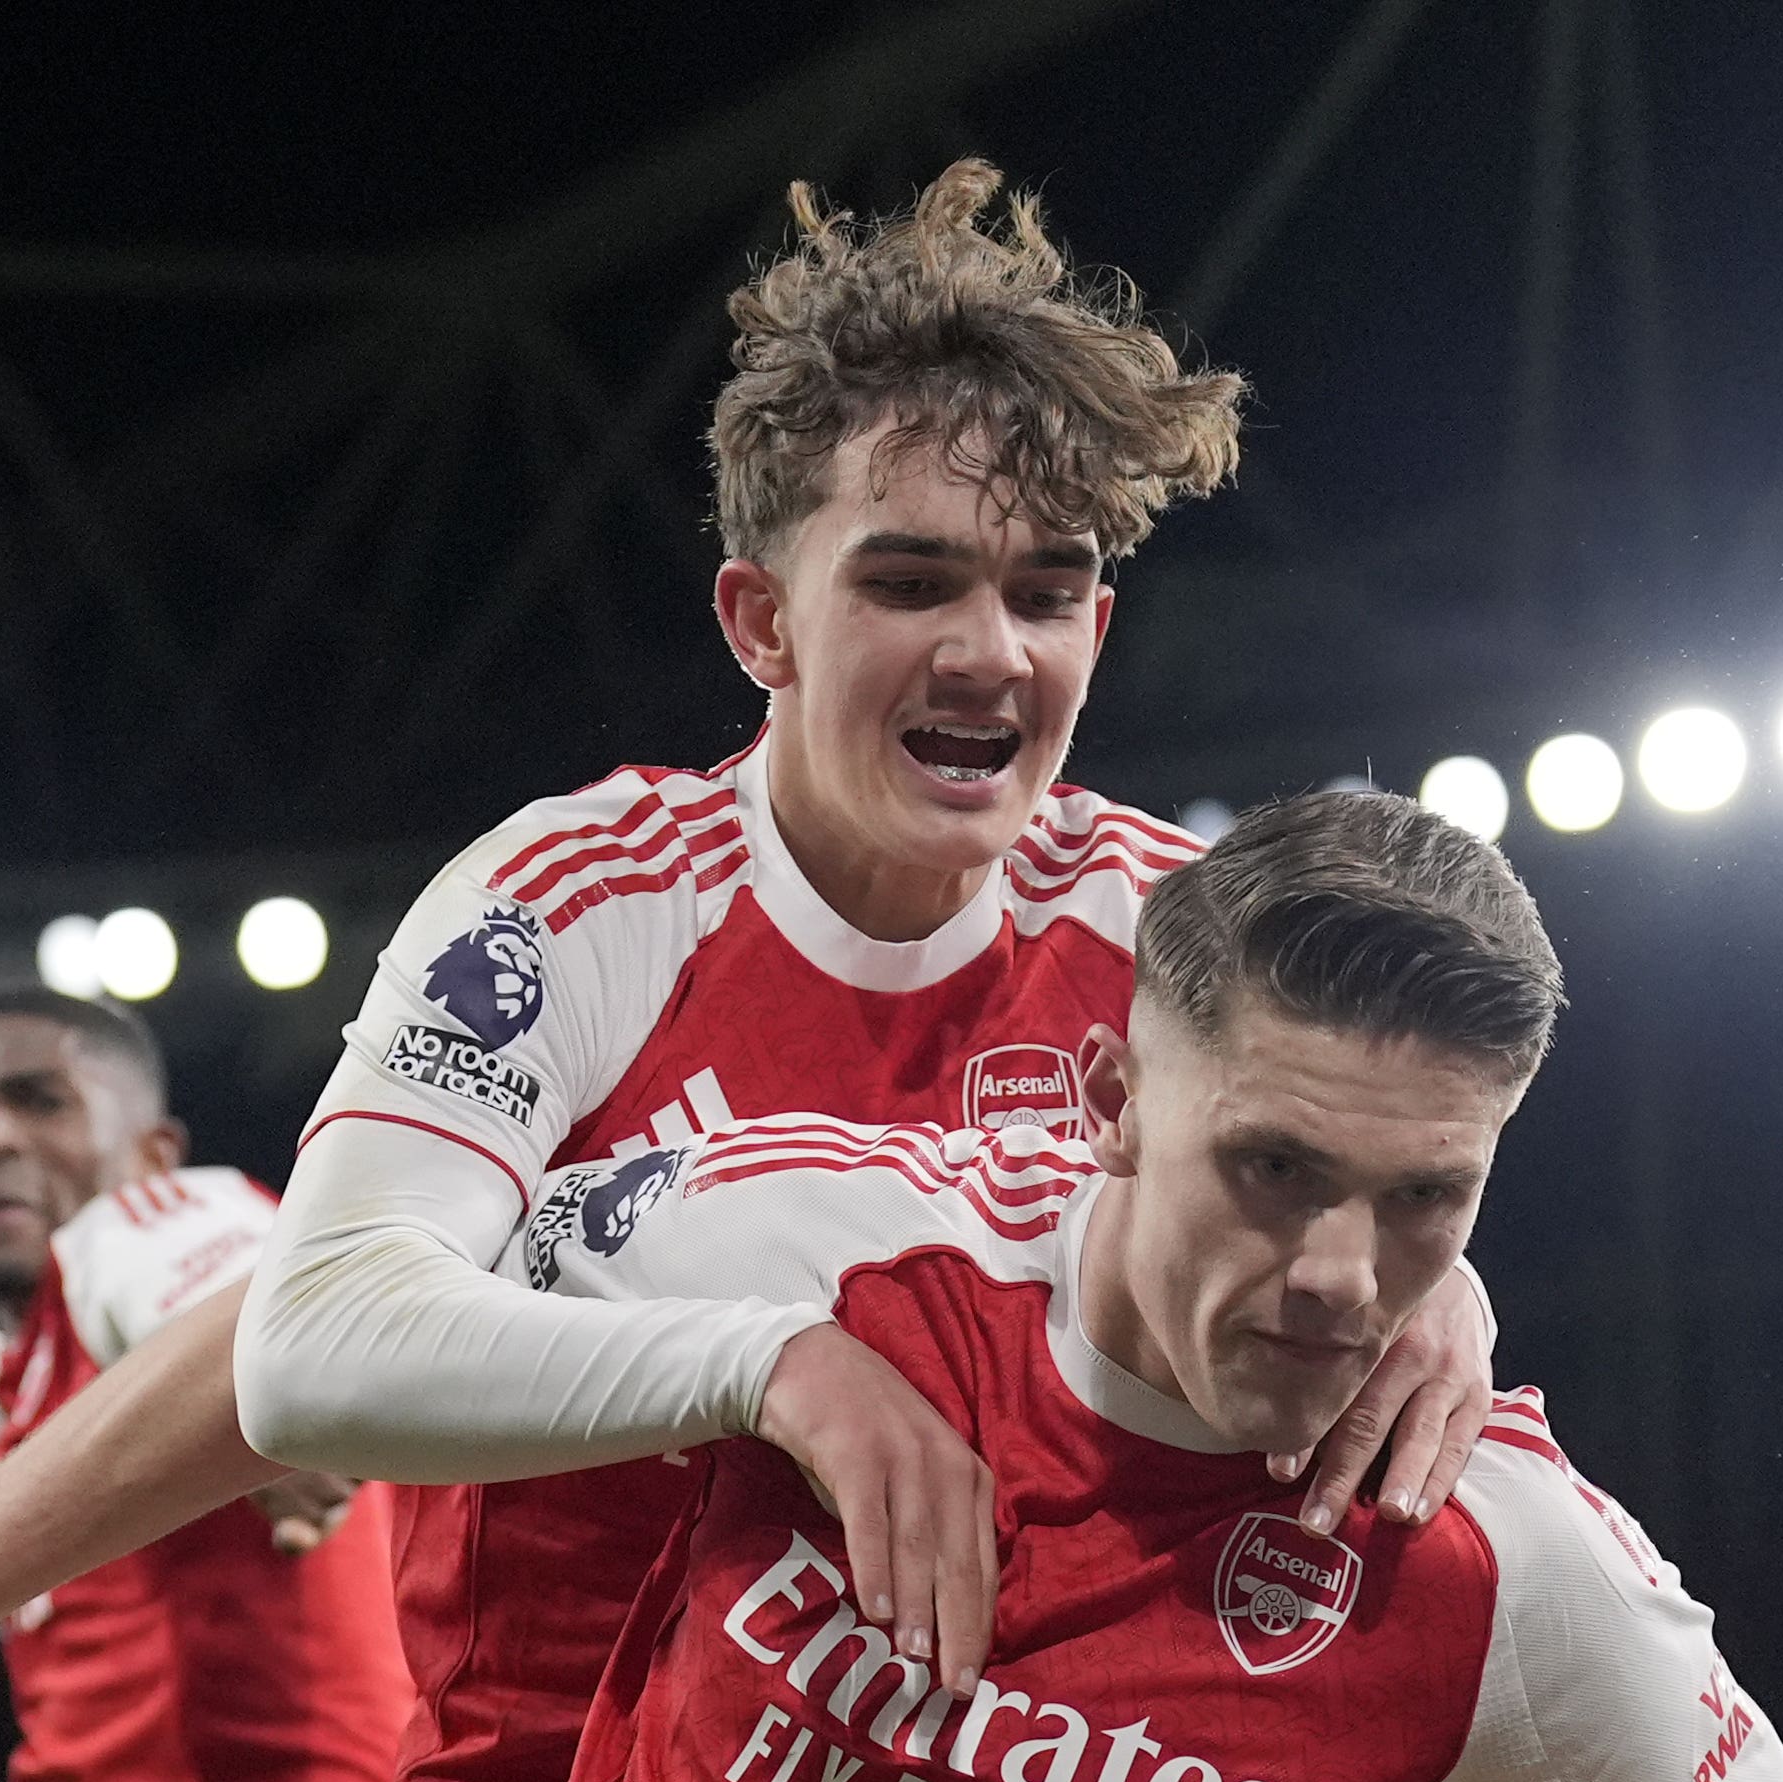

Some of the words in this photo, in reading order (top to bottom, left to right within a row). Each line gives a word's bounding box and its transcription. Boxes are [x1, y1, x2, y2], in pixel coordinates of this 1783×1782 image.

[390, 1026, 443, 1057] No
[445, 1040, 530, 1095] room
[979, 1071, 1064, 1097] Arsenal
[433, 1065, 533, 1128] racism
[1245, 1536, 1342, 1592] Arsenal
